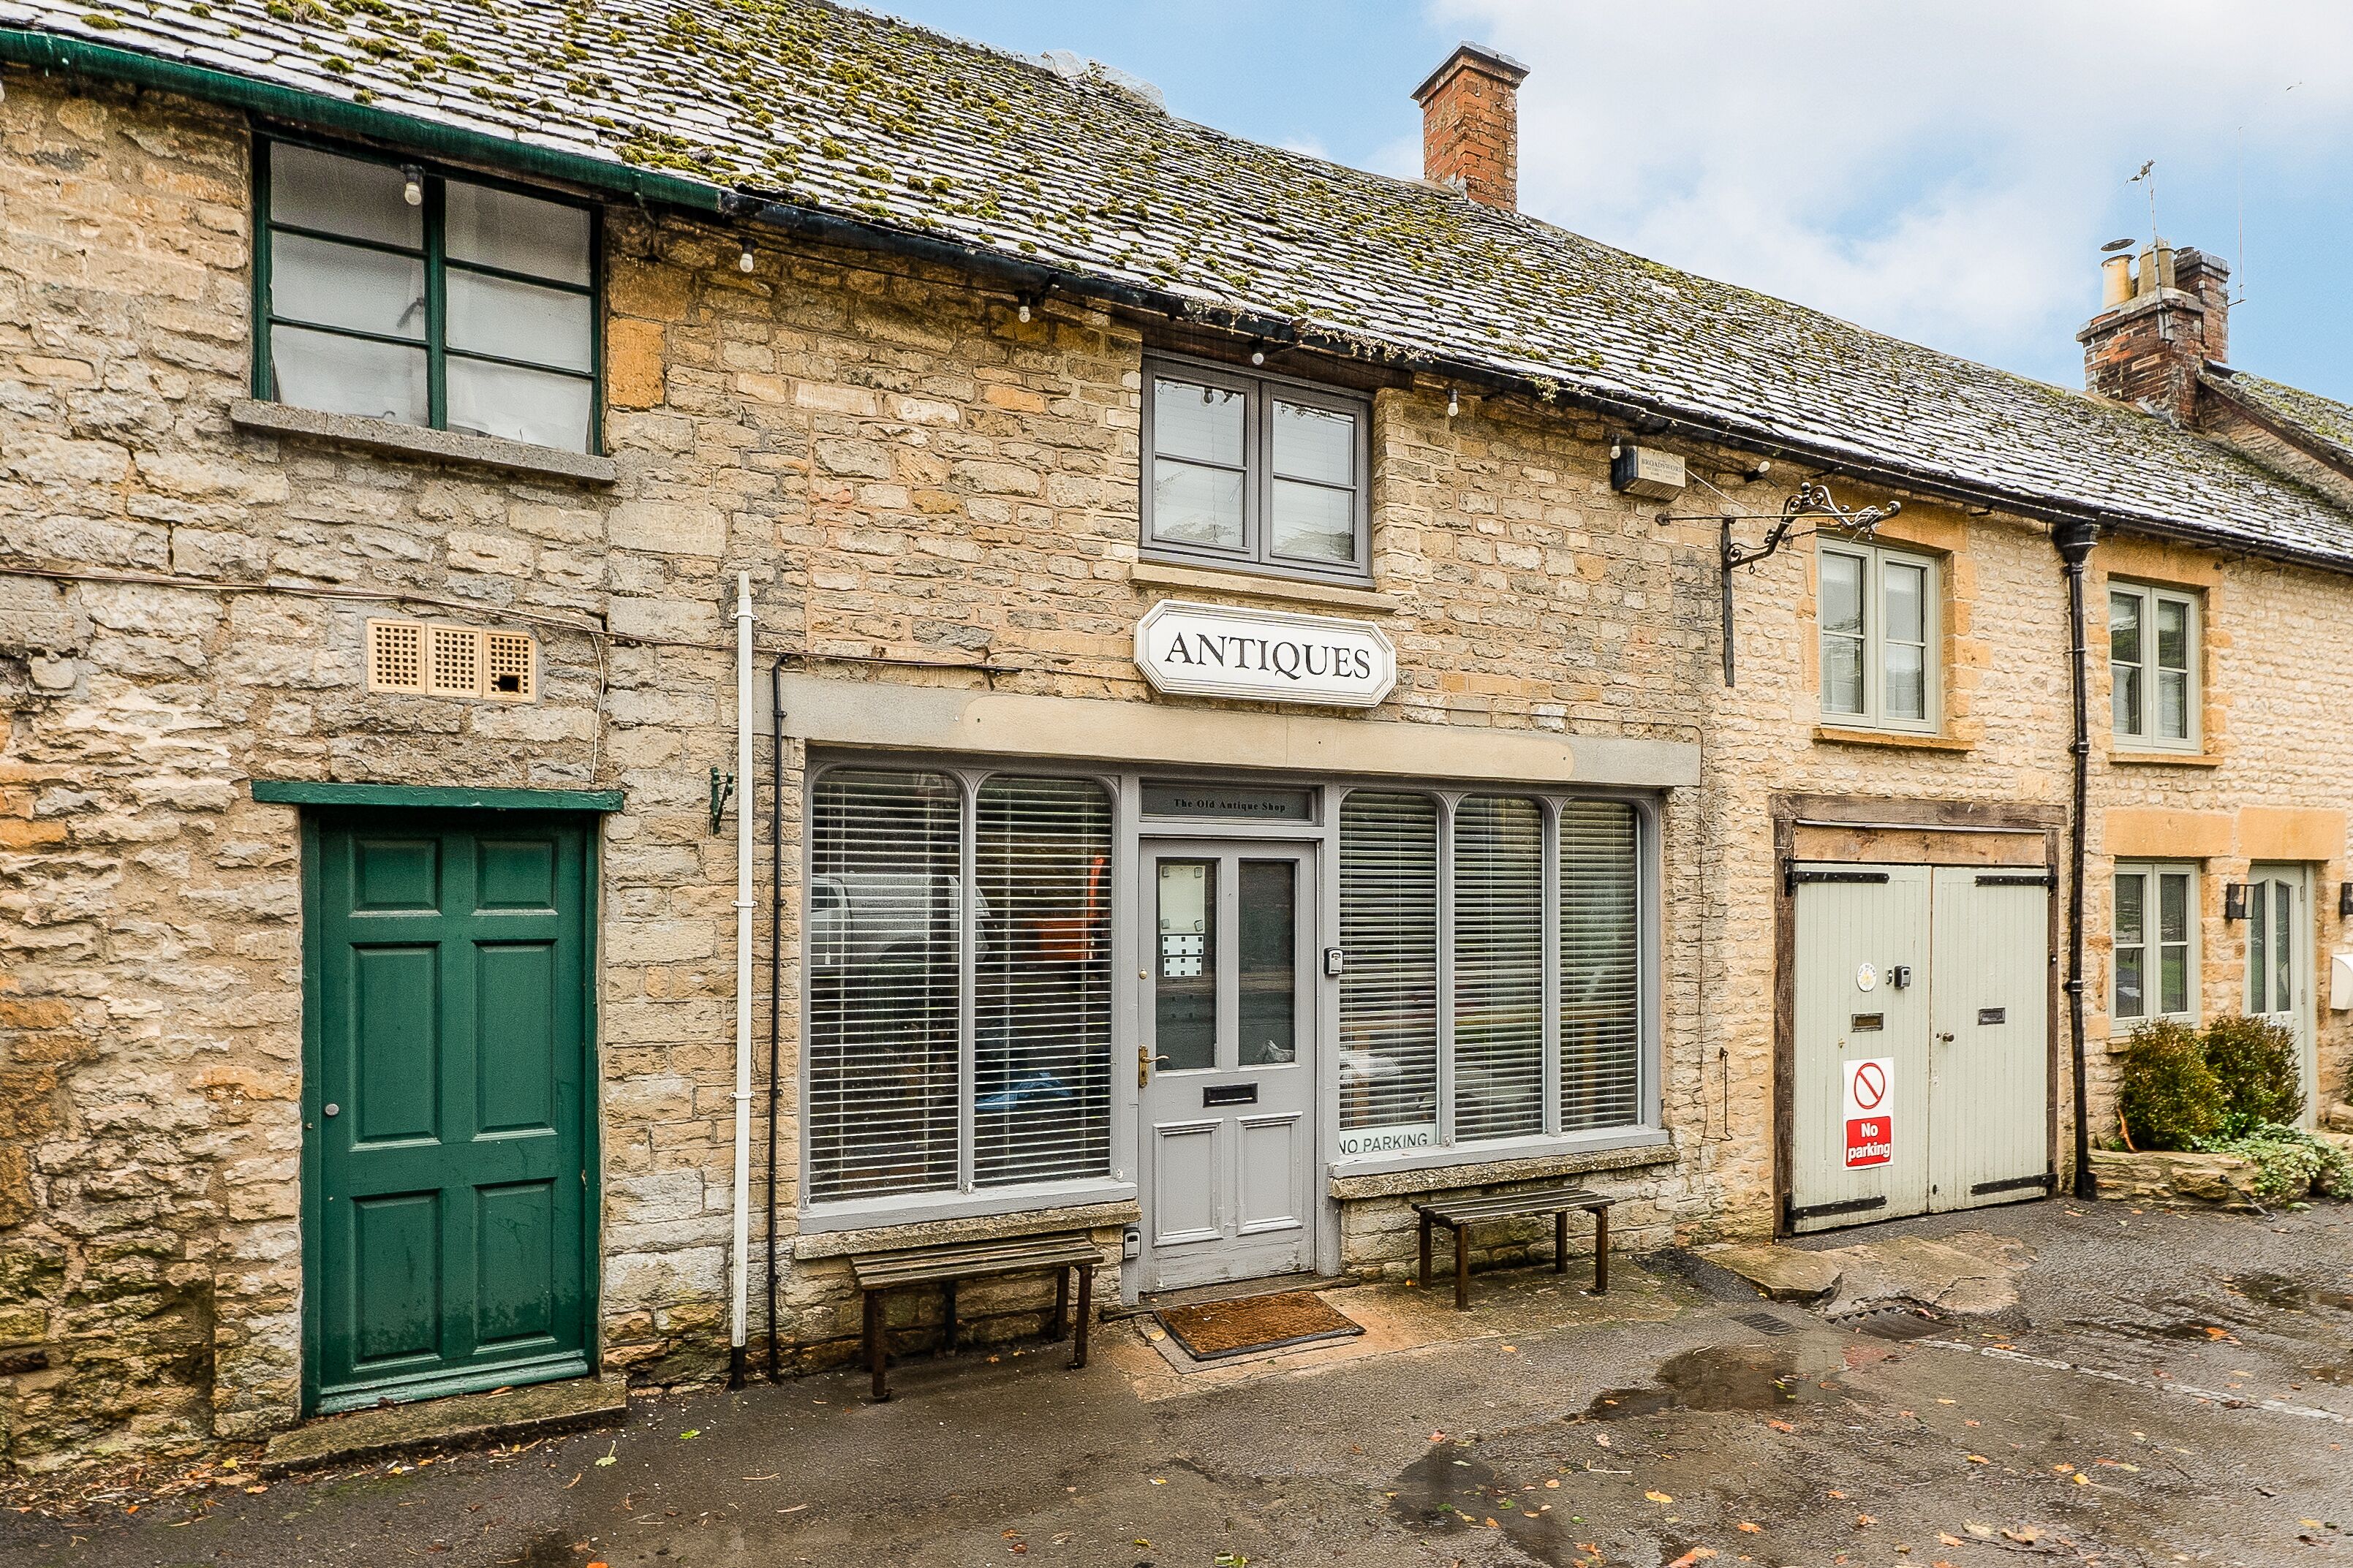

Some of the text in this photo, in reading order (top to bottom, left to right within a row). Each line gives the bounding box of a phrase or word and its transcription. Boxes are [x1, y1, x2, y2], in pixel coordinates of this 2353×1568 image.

[1641, 458, 1683, 473] BROADSWORD
[1165, 632, 1371, 680] ANTIQUES
[1174, 798, 1286, 813] The Old Antique Shop
[1860, 1122, 1878, 1137] No
[1339, 1132, 1428, 1154] NO PARKING
[1847, 1141, 1891, 1163] parking
